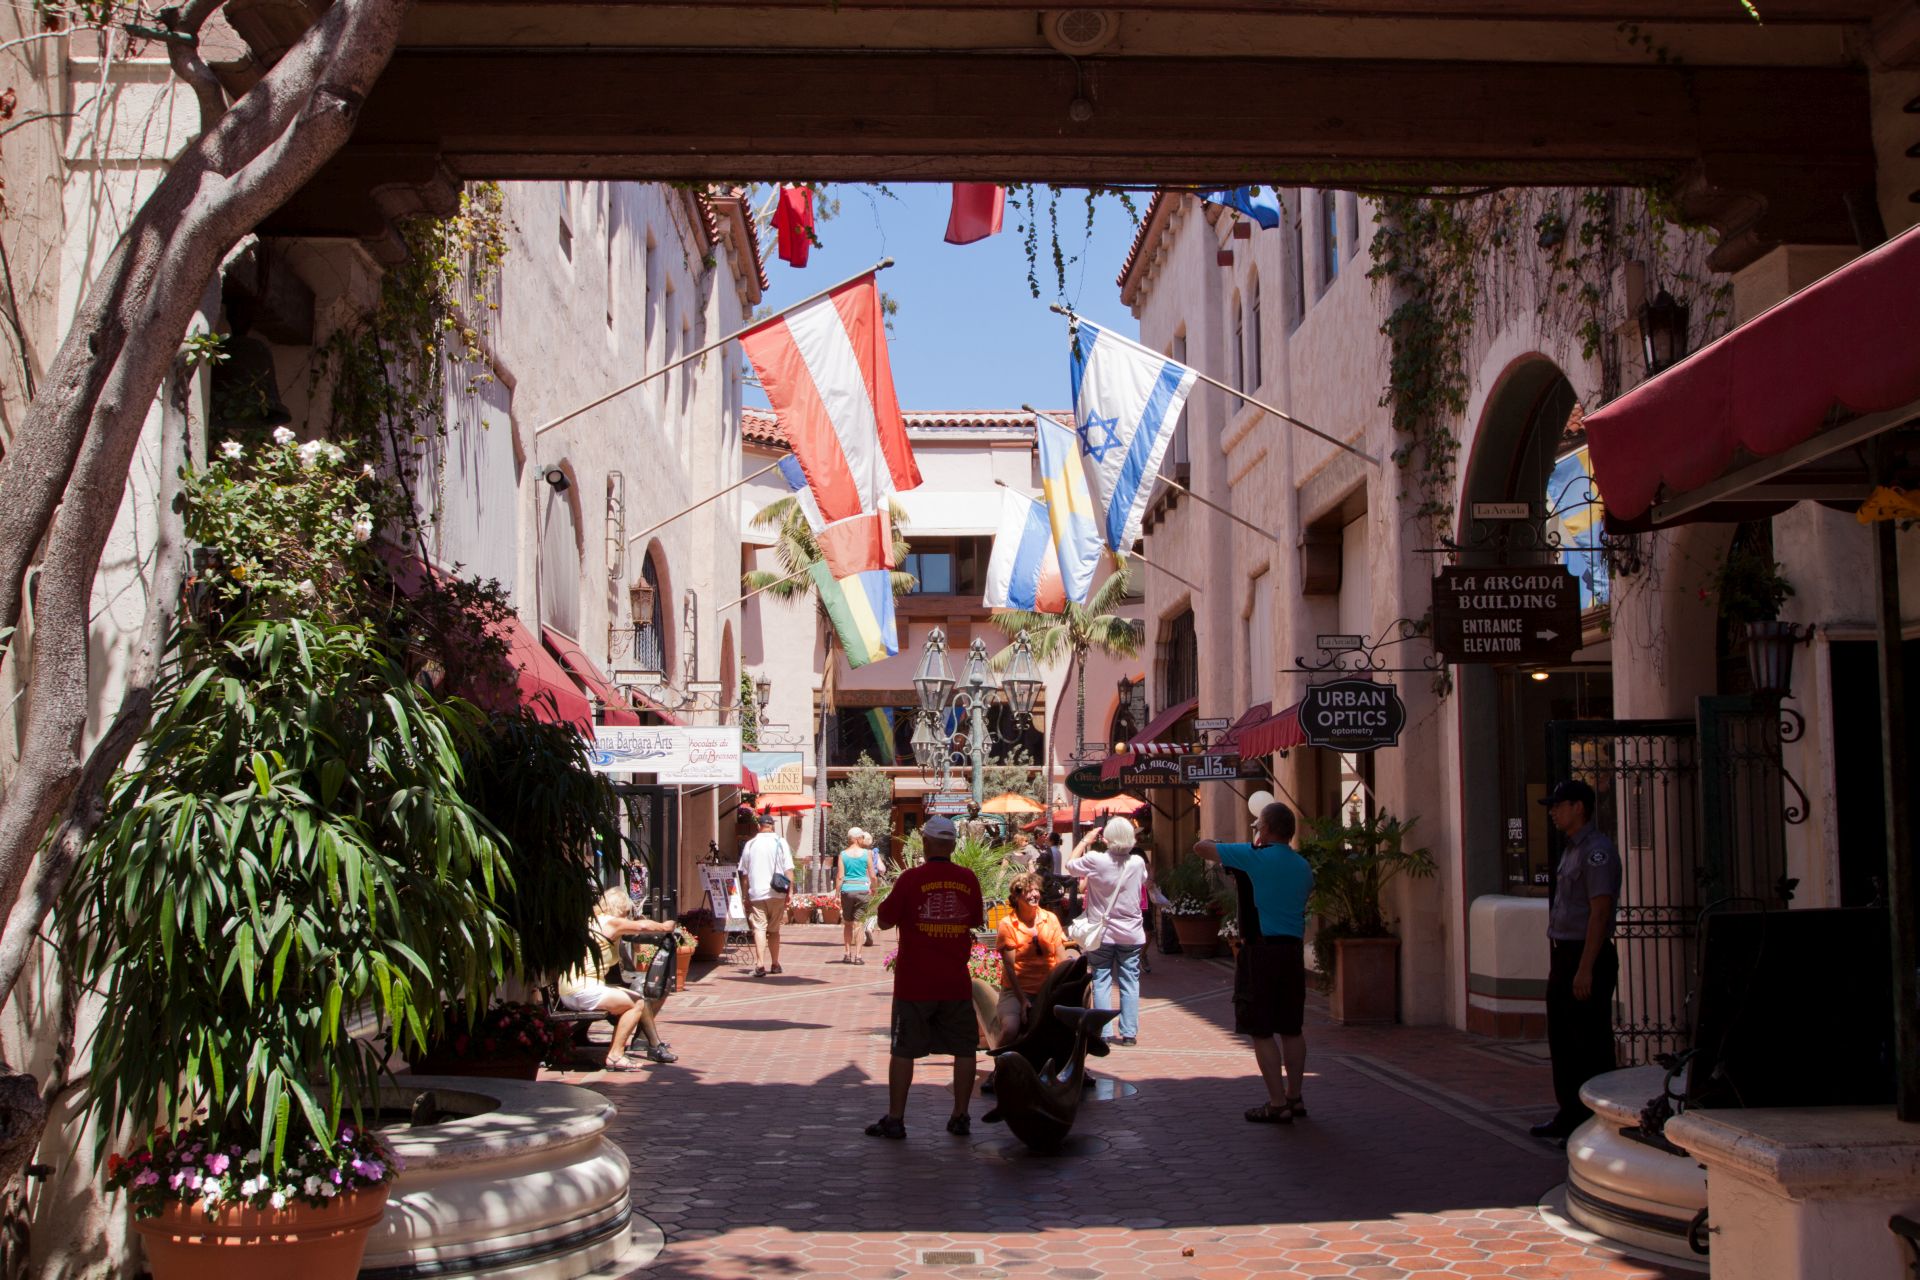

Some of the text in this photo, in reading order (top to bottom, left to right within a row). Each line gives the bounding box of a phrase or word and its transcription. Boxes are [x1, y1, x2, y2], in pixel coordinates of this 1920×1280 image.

[1477, 504, 1525, 515] La Arcada
[1449, 575, 1564, 591] LA ARCADA
[1458, 594, 1557, 609] BUILDING
[1462, 618, 1523, 633] ENTRANCE
[1463, 637, 1521, 653] ELEVATOR
[1317, 691, 1386, 707] URBAN
[1317, 710, 1387, 726] OPTICS
[1331, 727, 1374, 736] optometry
[594, 731, 673, 749] anta Barbara Arts
[689, 736, 718, 747] hocolats
[1133, 759, 1180, 774] LA ARCAD
[763, 773, 800, 784] WINE
[1124, 774, 1164, 784] BARBER
[1508, 817, 1522, 828] URBAN
[1508, 828, 1523, 840] OPTICS
